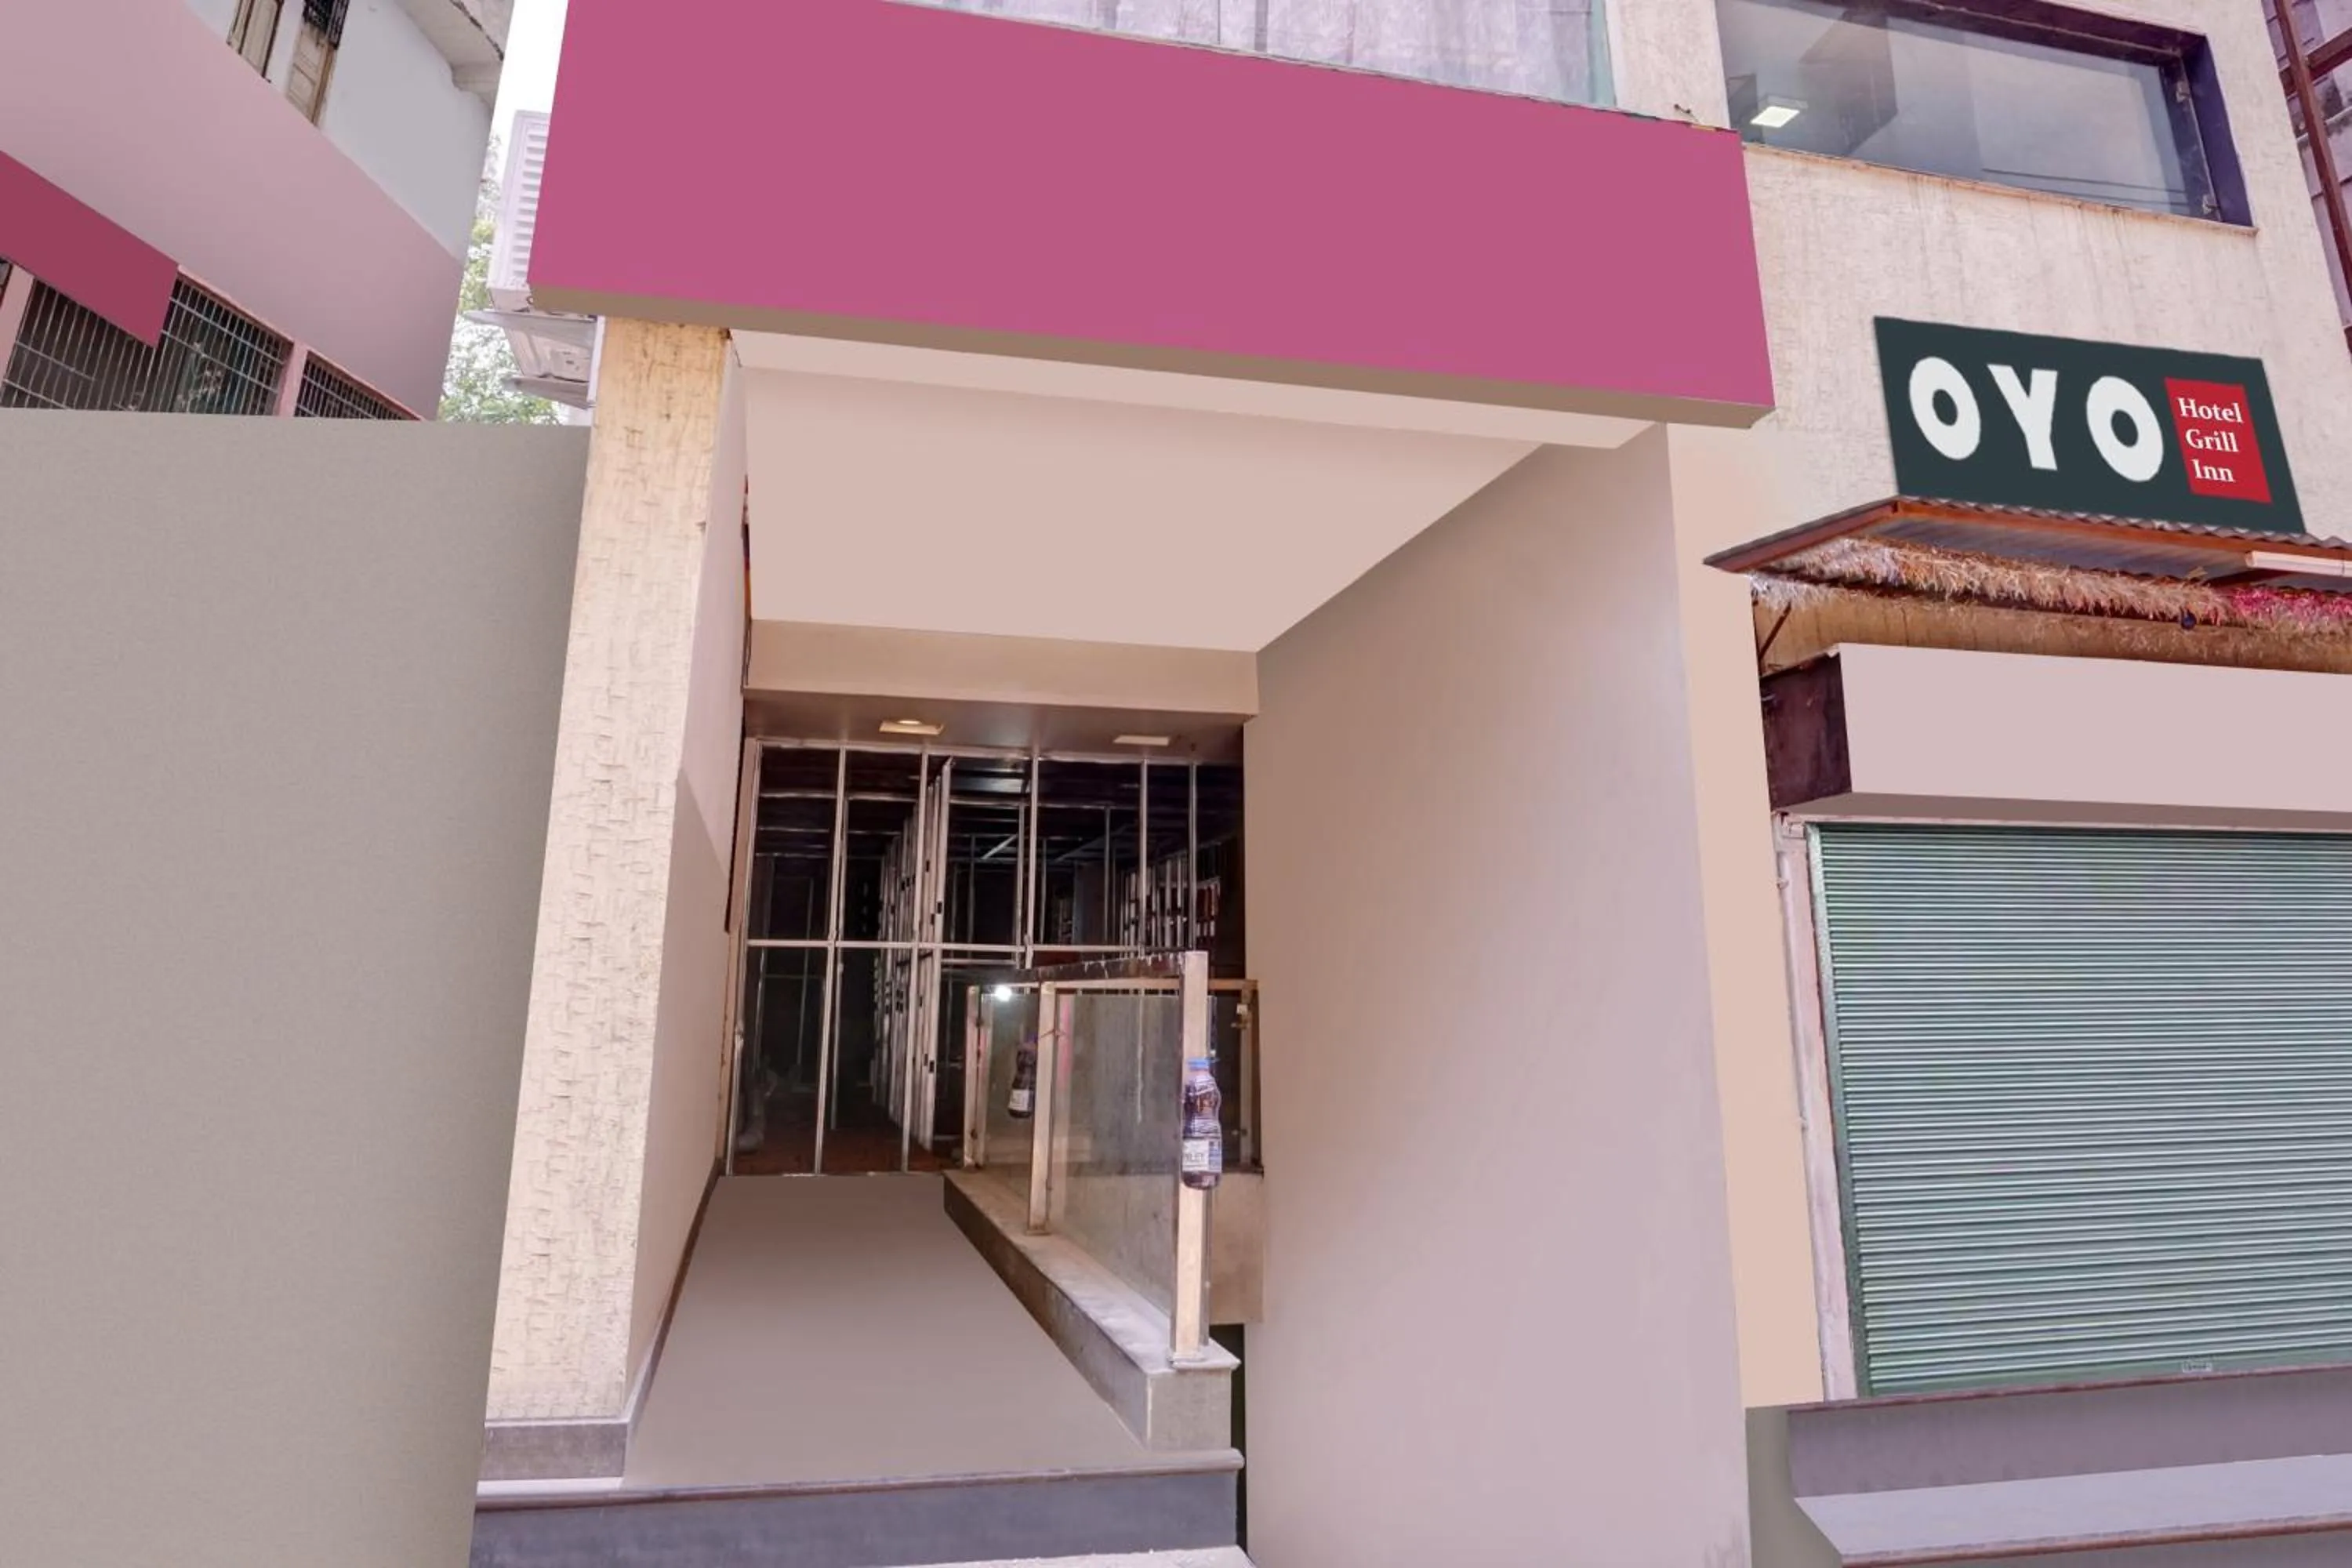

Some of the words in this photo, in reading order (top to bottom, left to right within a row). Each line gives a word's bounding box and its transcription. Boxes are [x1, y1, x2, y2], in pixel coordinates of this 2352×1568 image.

[1909, 357, 2164, 482] OYO
[2177, 397, 2244, 423] Hotel
[2185, 428, 2239, 453] Grill
[2191, 459, 2236, 482] Inn
